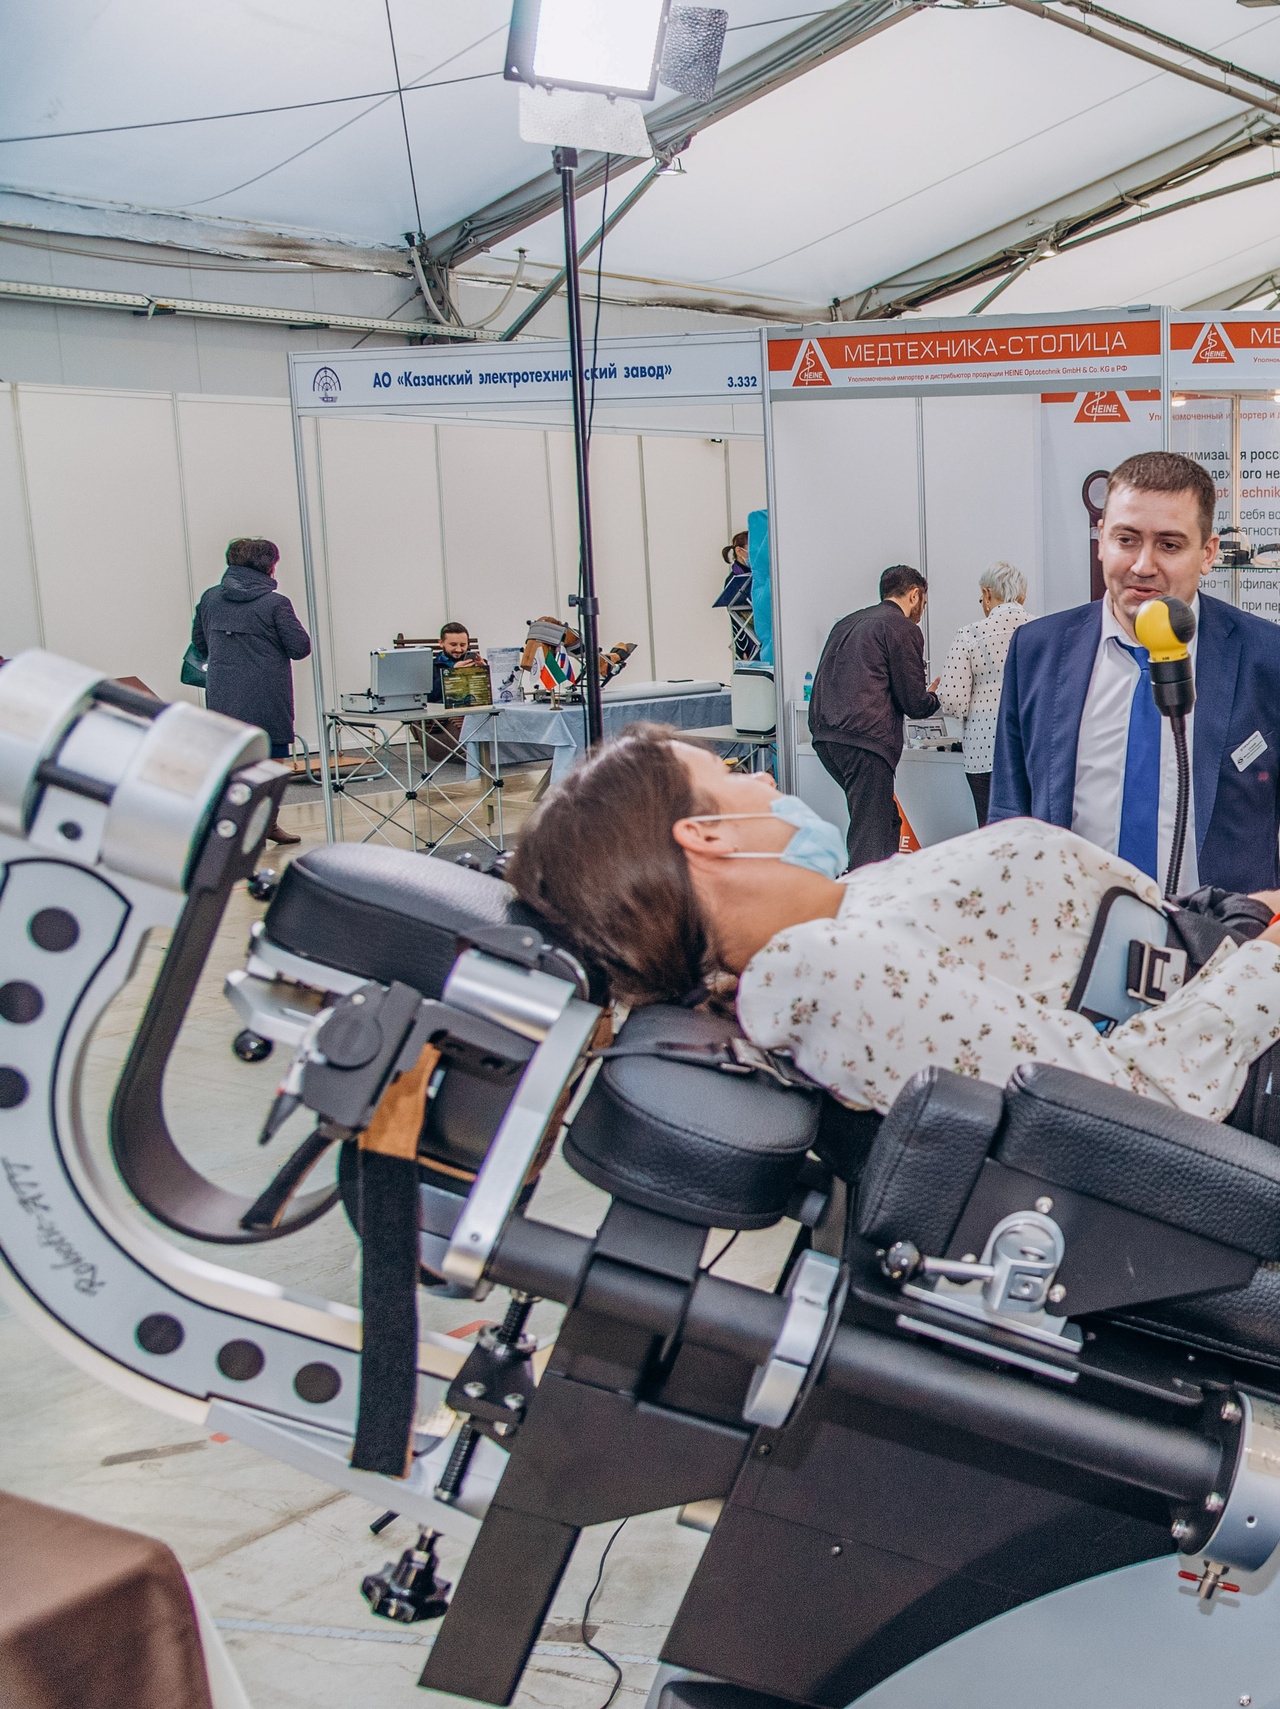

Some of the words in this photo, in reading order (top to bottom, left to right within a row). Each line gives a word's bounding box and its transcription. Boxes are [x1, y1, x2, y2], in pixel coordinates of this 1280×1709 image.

[844, 332, 1126, 364] МЕДТЕХНИКА-СТОЛИЦА
[373, 372, 391, 388] АО
[398, 370, 472, 386] «Казанский
[479, 363, 617, 388] электротехничский
[624, 364, 672, 380] завод»
[897, 374, 922, 382] импортер
[930, 372, 971, 380] дистрибьютор
[1024, 368, 1060, 376] Optotechnik
[1062, 366, 1082, 374] GmbH
[727, 376, 757, 388] 3.332
[1092, 404, 1118, 413] HEINE
[1240, 509, 1265, 520] себя
[1242, 602, 1262, 612] при
